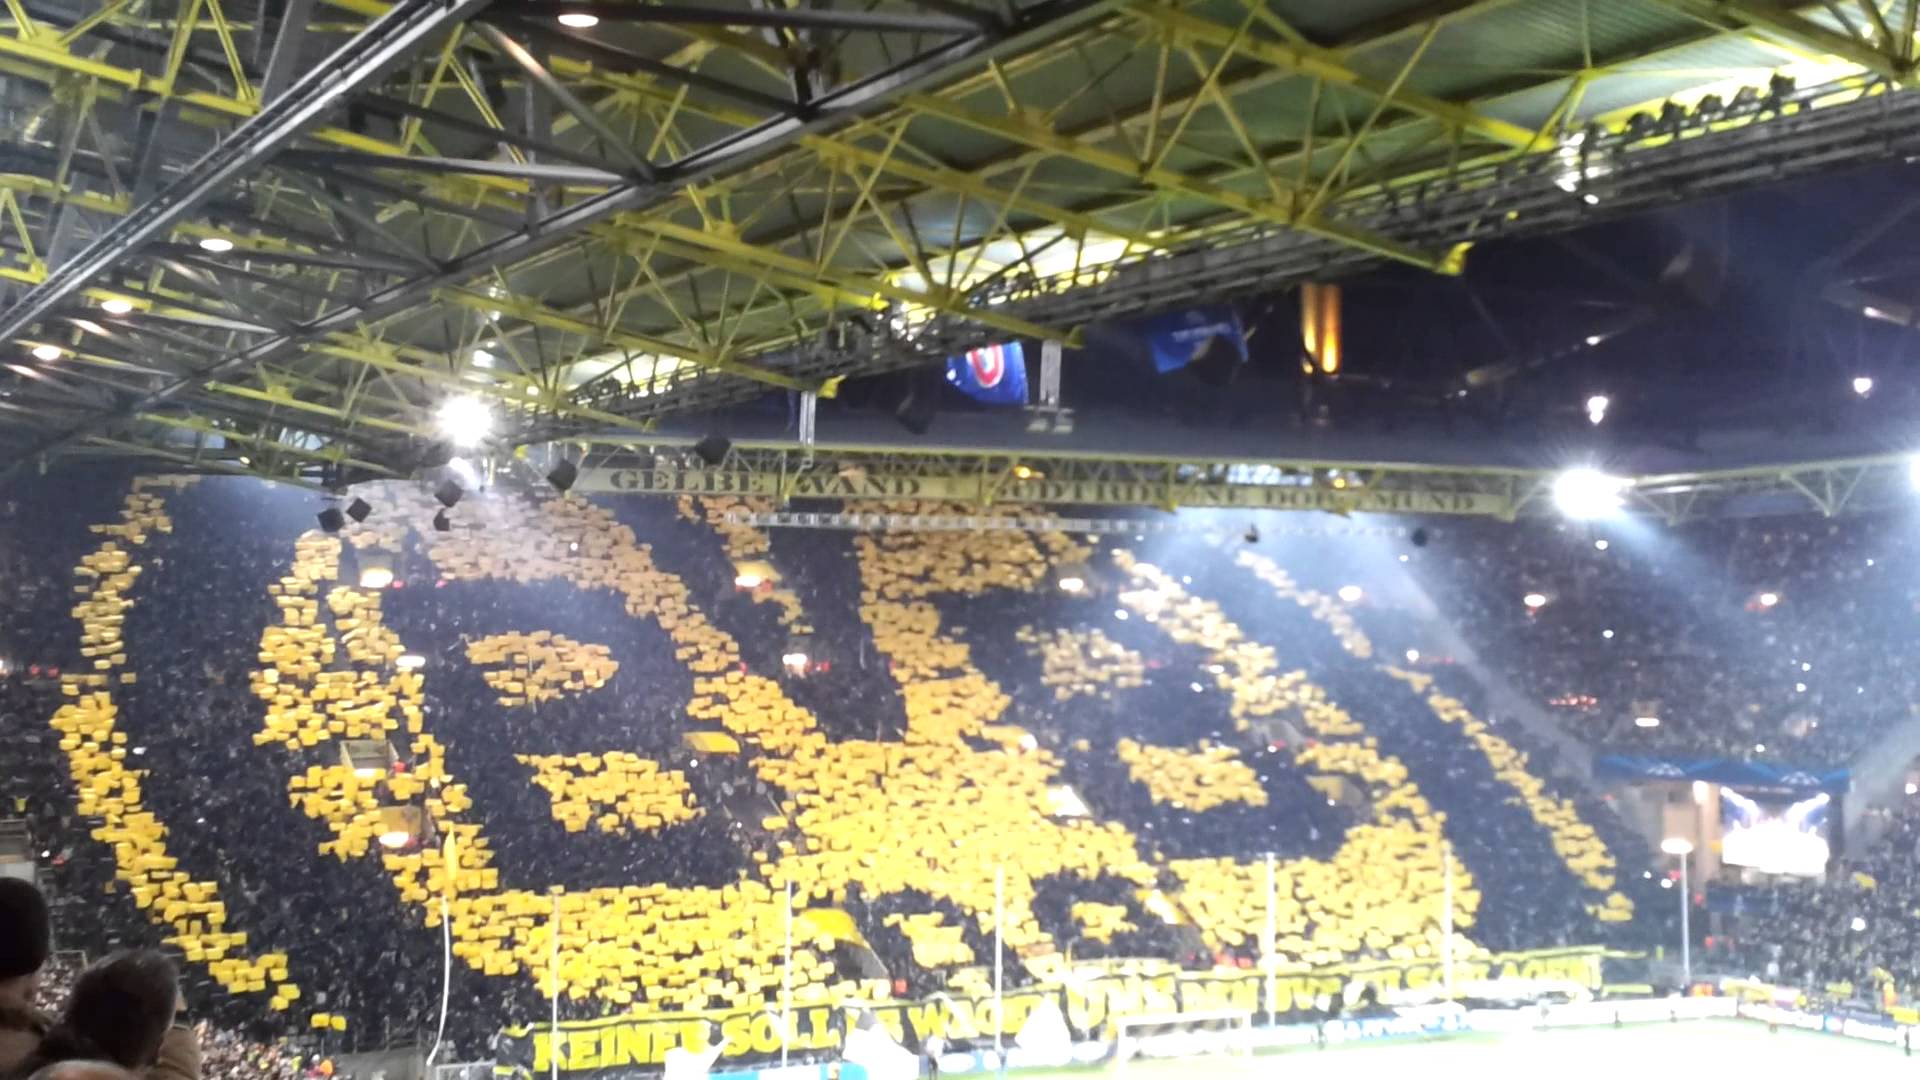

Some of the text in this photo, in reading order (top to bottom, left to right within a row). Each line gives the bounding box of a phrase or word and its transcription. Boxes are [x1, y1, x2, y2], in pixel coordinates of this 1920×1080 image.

[610, 470, 766, 492] GELBE
[795, 475, 921, 496] WAND
[1266, 487, 1476, 512] DORMUND
[721, 1007, 841, 1056] SOLL
